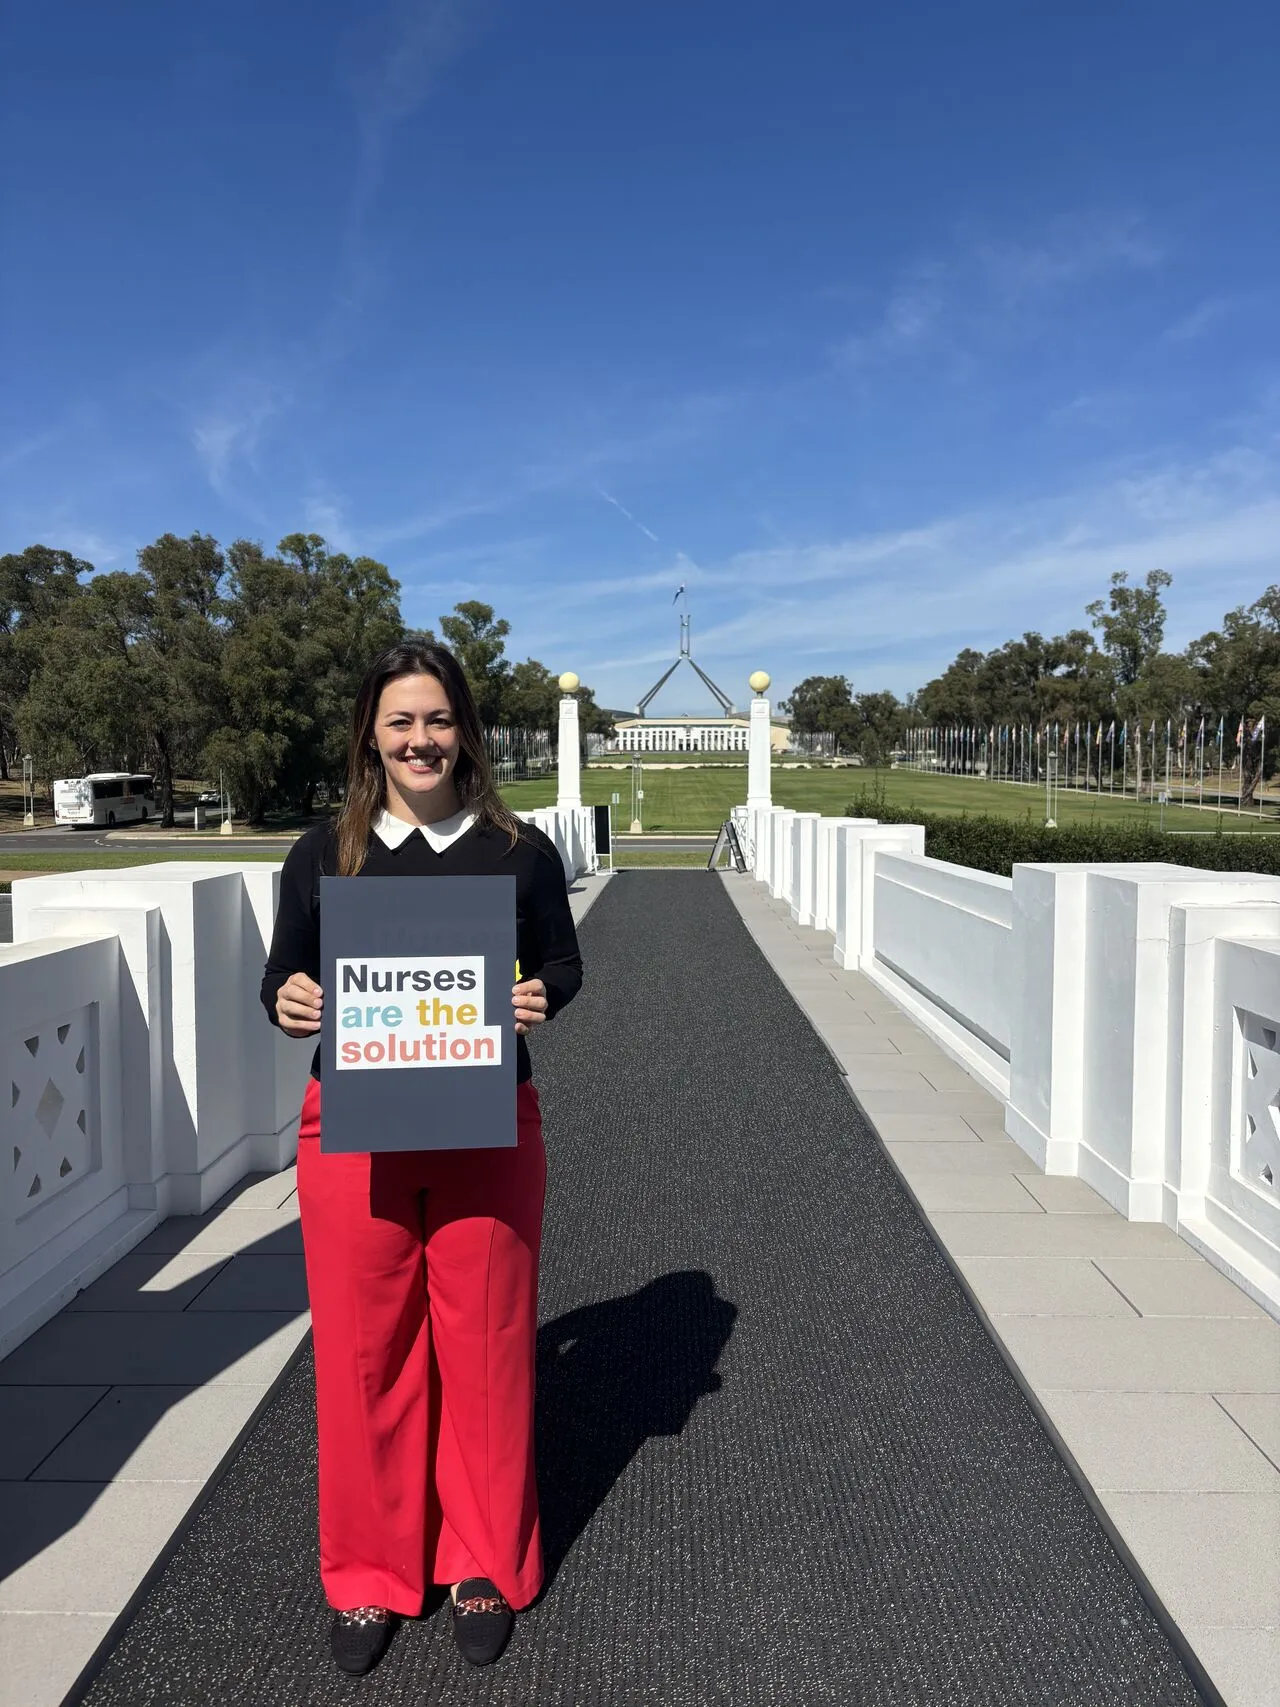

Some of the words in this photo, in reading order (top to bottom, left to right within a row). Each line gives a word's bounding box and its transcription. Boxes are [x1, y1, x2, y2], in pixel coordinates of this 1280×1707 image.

[342, 964, 477, 993] Nurses
[341, 1005, 403, 1028] are
[416, 997, 478, 1026] the
[341, 1032, 494, 1063] solution
